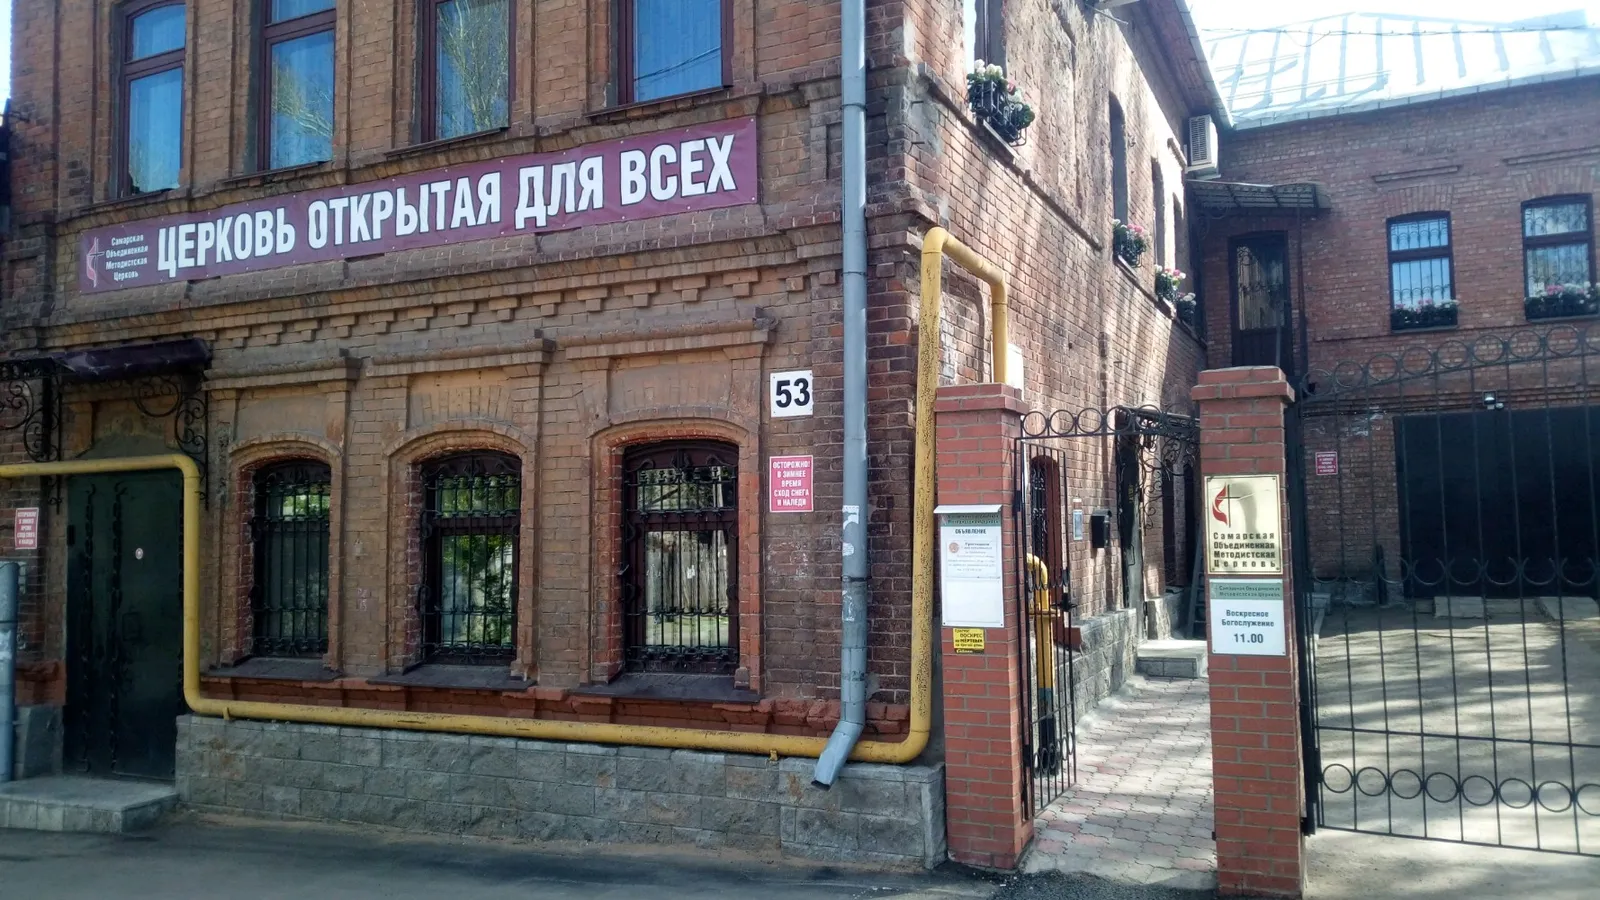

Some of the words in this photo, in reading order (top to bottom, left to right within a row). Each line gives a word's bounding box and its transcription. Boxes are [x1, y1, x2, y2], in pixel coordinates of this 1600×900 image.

[157, 207, 296, 278] ЦЕРКОВЬ
[308, 171, 501, 249] ОТКРЫТАЯ
[514, 155, 604, 230] ДЛЯ
[620, 134, 737, 206] ВСЕХ
[111, 234, 144, 246] Самарская
[105, 245, 149, 259] Объединенная
[105, 257, 148, 270] Методистская
[113, 271, 139, 281] Церковь
[776, 378, 810, 408] 53
[782, 470, 806, 478] ЗИМНЕЕ
[774, 489, 790, 497] СХОД
[782, 498, 806, 507] НАЛЕДИ
[1213, 532, 1275, 540] Самарская
[1213, 541, 1275, 549] Объединенная
[1213, 551, 1276, 559] Методистская
[1214, 560, 1276, 568] Церковь
[1226, 609, 1269, 618] Воскресное
[1221, 619, 1275, 628] Богослужение
[1233, 633, 1264, 643] 11.00
